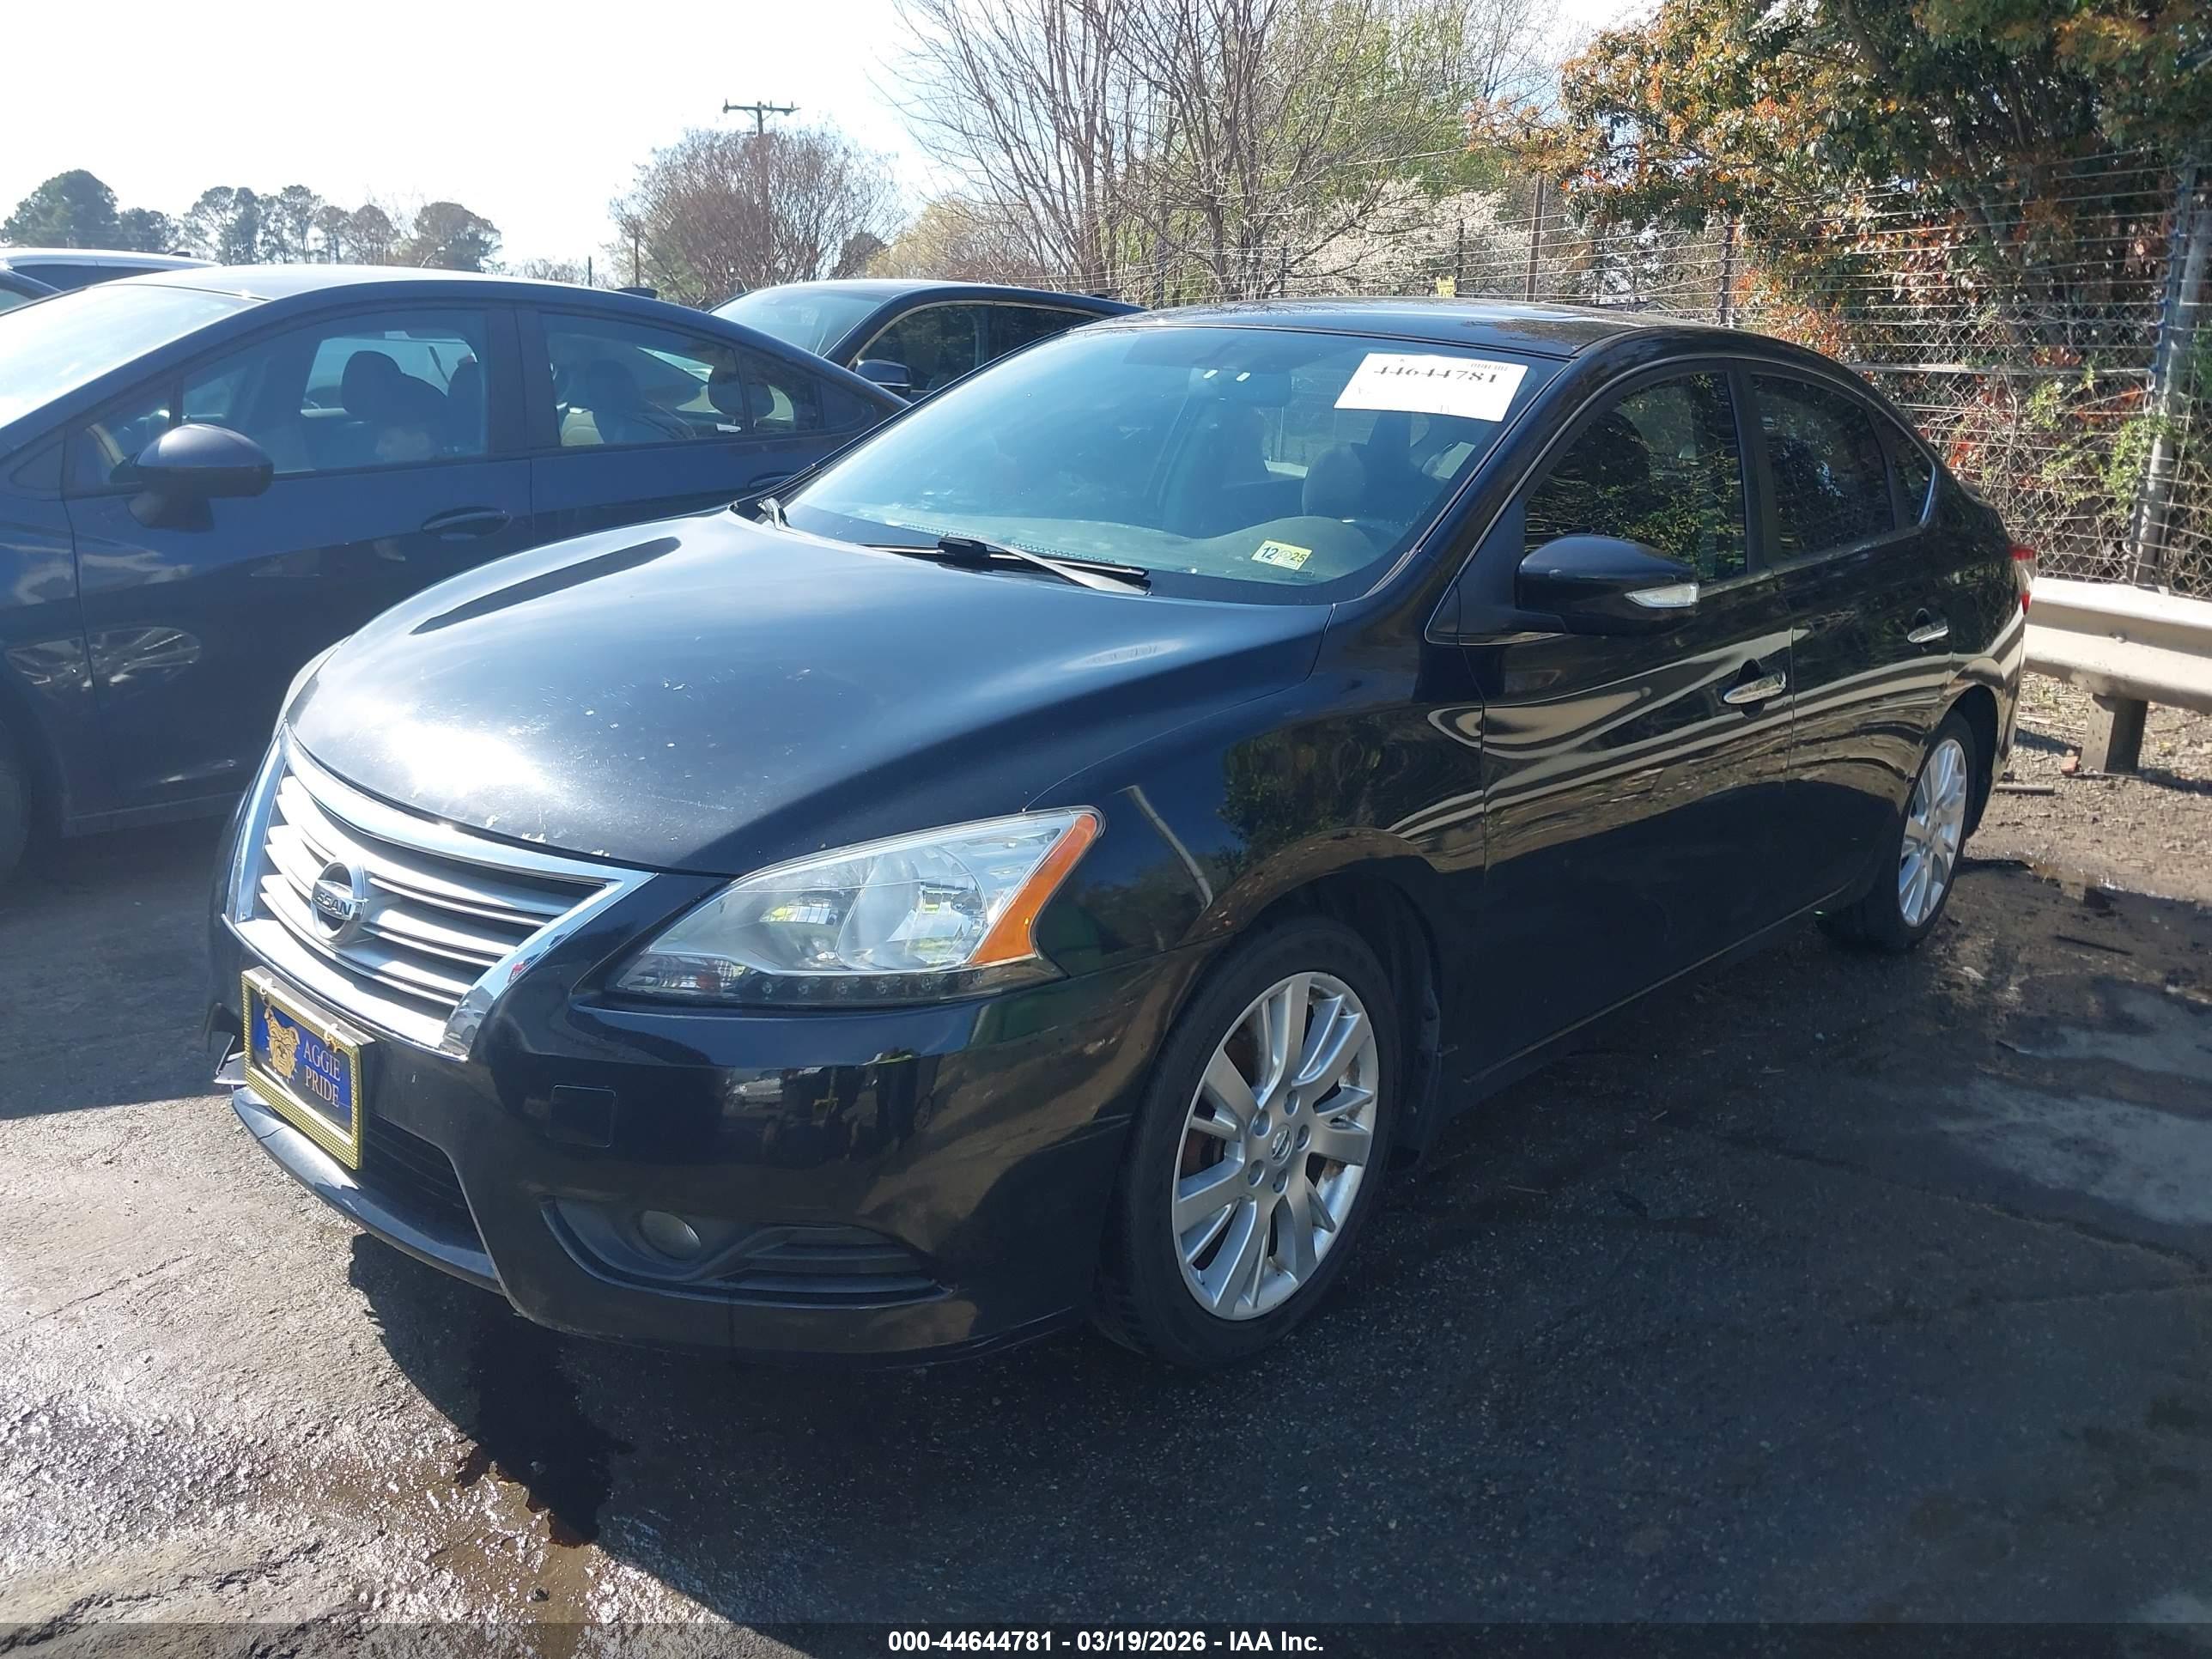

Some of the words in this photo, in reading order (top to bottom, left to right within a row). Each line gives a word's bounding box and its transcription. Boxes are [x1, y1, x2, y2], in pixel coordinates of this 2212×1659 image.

[1261, 546, 1279, 560] 12
[1290, 551, 1307, 563] 25
[303, 1039, 342, 1082] AGGIE
[305, 1064, 340, 1108] PRIDE
